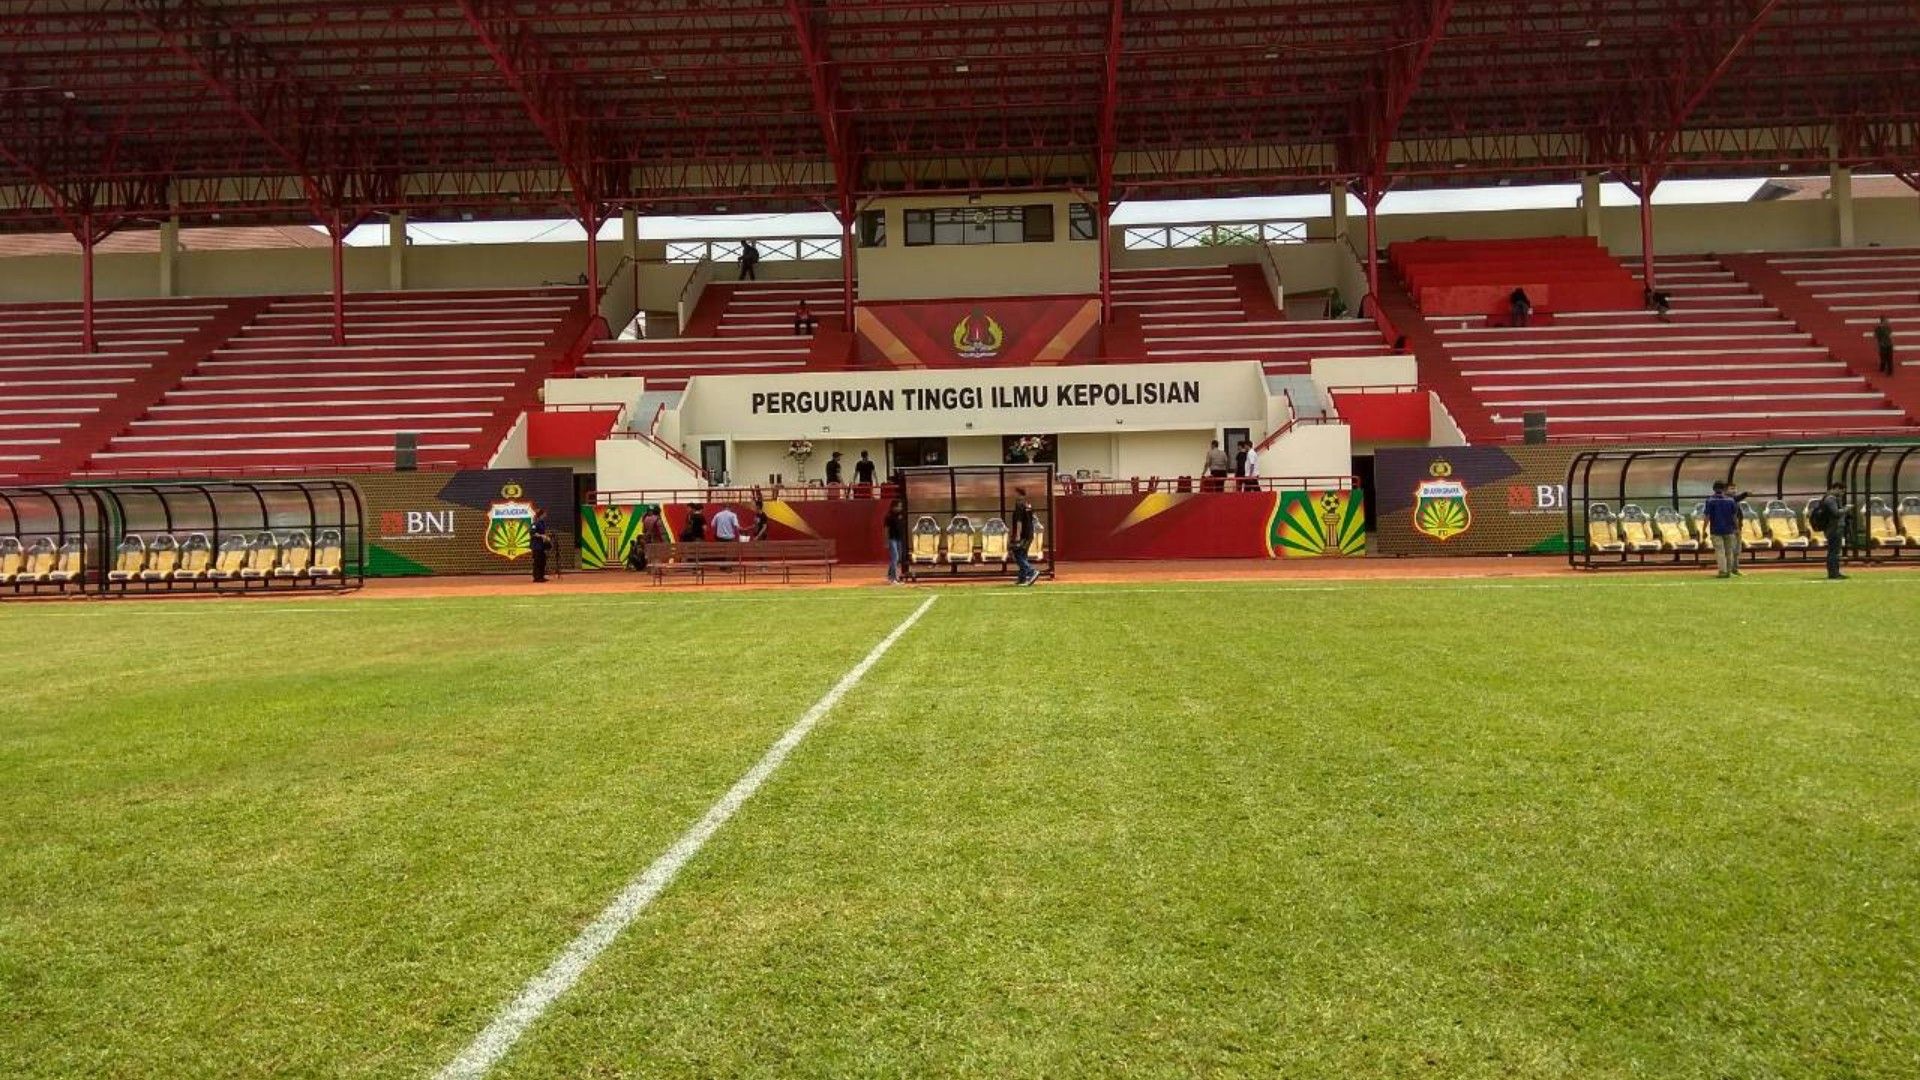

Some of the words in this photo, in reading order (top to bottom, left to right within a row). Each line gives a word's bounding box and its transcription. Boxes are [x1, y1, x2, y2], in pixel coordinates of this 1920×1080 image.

[752, 389, 895, 414] PERGURUAN
[901, 387, 983, 411] TINGGI
[991, 385, 1048, 408] ILMU
[1056, 381, 1200, 406] KEPOLISIAN
[407, 510, 455, 533] BNI
